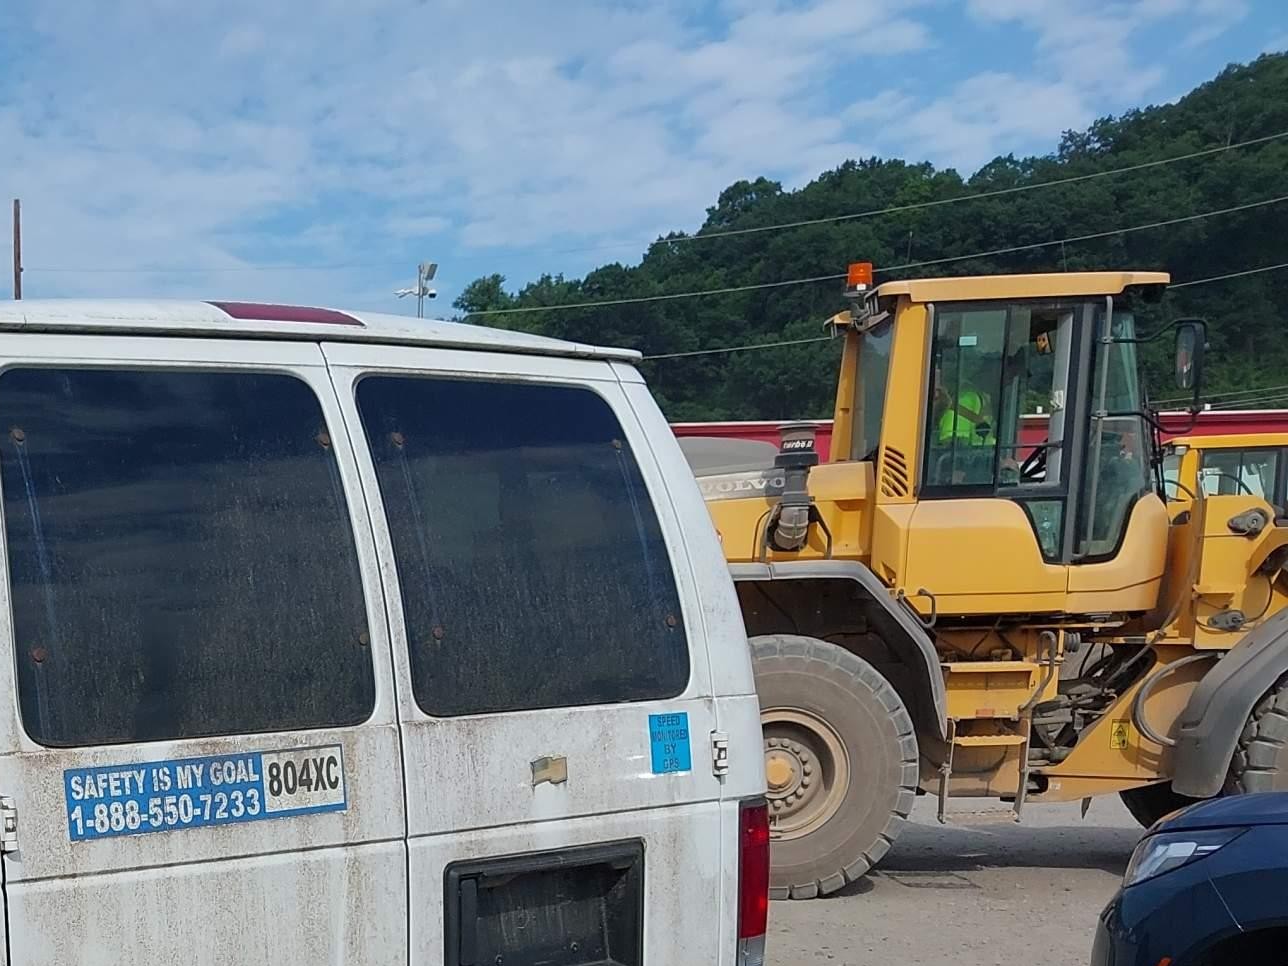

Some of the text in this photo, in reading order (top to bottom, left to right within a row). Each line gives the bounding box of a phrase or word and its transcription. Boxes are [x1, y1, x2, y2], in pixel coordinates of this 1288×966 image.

[657, 715, 681, 727] SPEED
[652, 729, 688, 742] MONITORED
[664, 743, 677, 755] BY
[663, 758, 680, 770] GPS
[71, 758, 260, 800] SAFETY IS MY GOAL
[268, 755, 340, 797] 804XC
[70, 788, 261, 835] 1-888-550-7233
